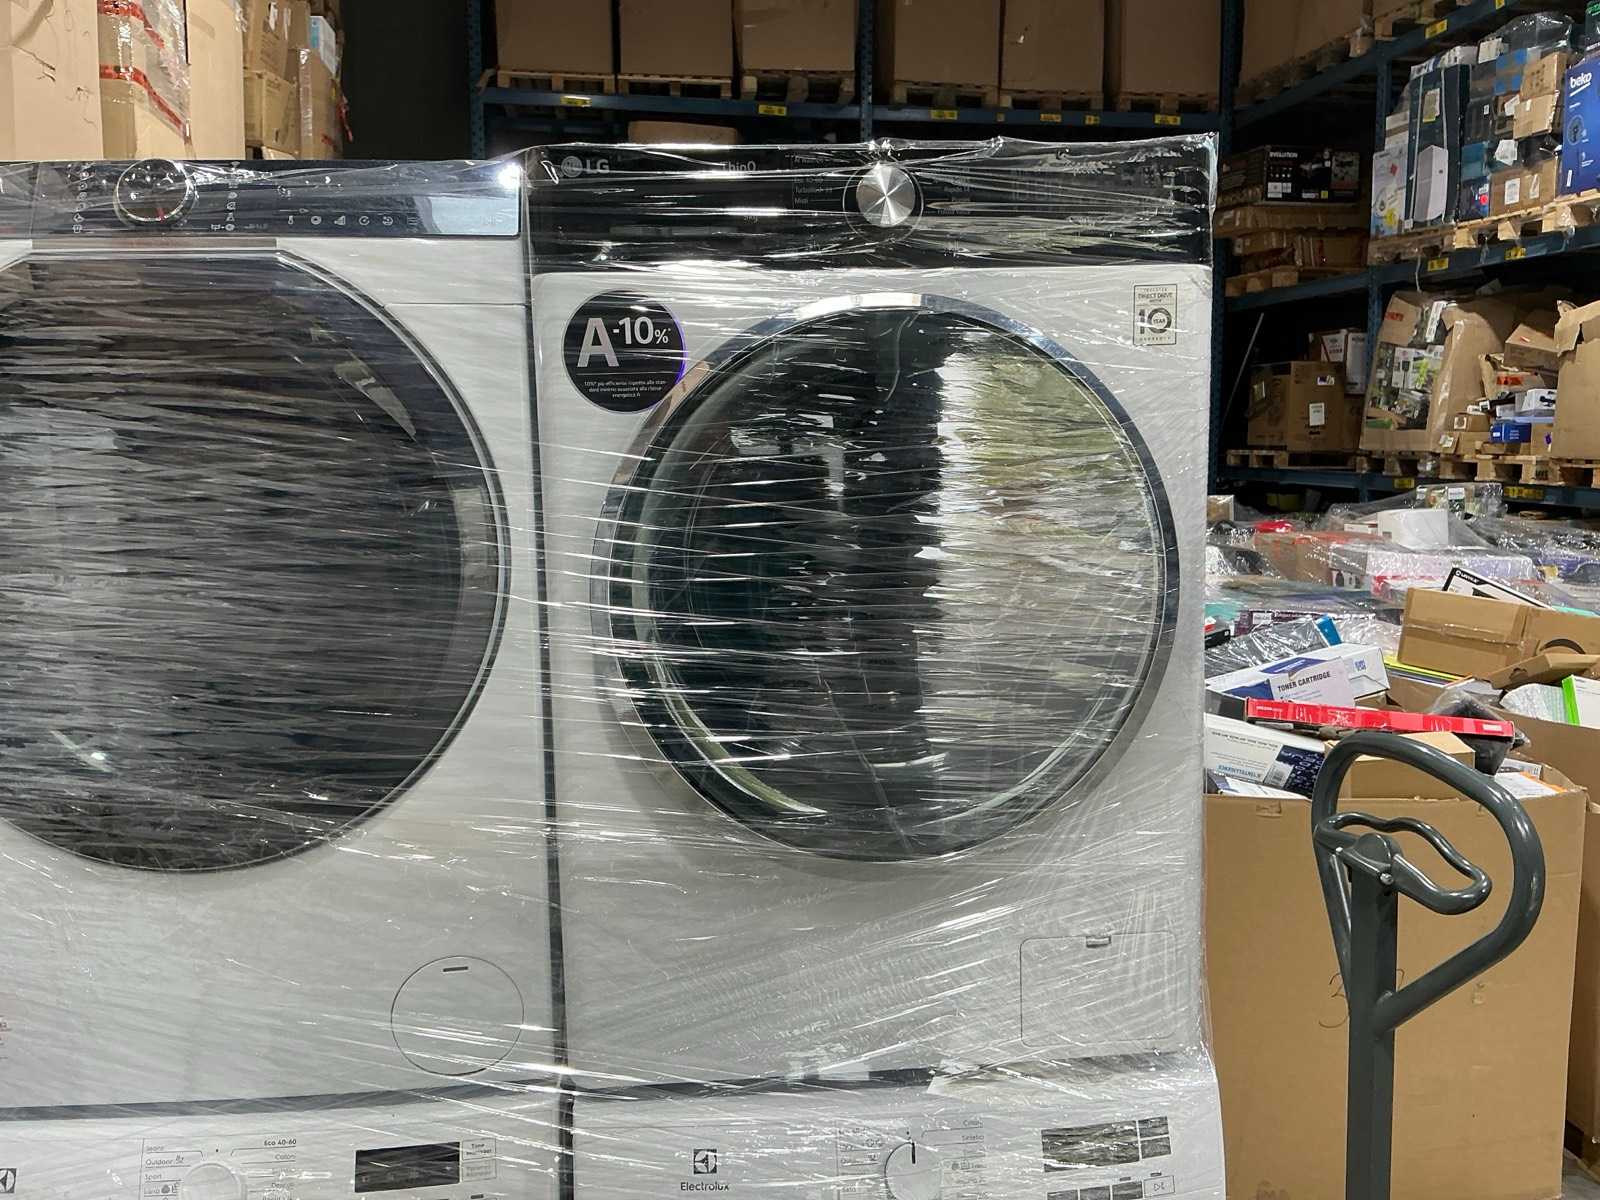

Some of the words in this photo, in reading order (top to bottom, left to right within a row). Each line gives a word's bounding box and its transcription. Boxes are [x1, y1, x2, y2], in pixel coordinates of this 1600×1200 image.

[1569, 71, 1593, 90] beko
[586, 159, 610, 174] LG
[576, 317, 620, 367] A
[1277, 681, 1298, 693] TONER
[1297, 670, 1332, 687] CARTRIDGE
[277, 1138, 297, 1146] 40-60
[680, 1181, 730, 1191] Electrolux
